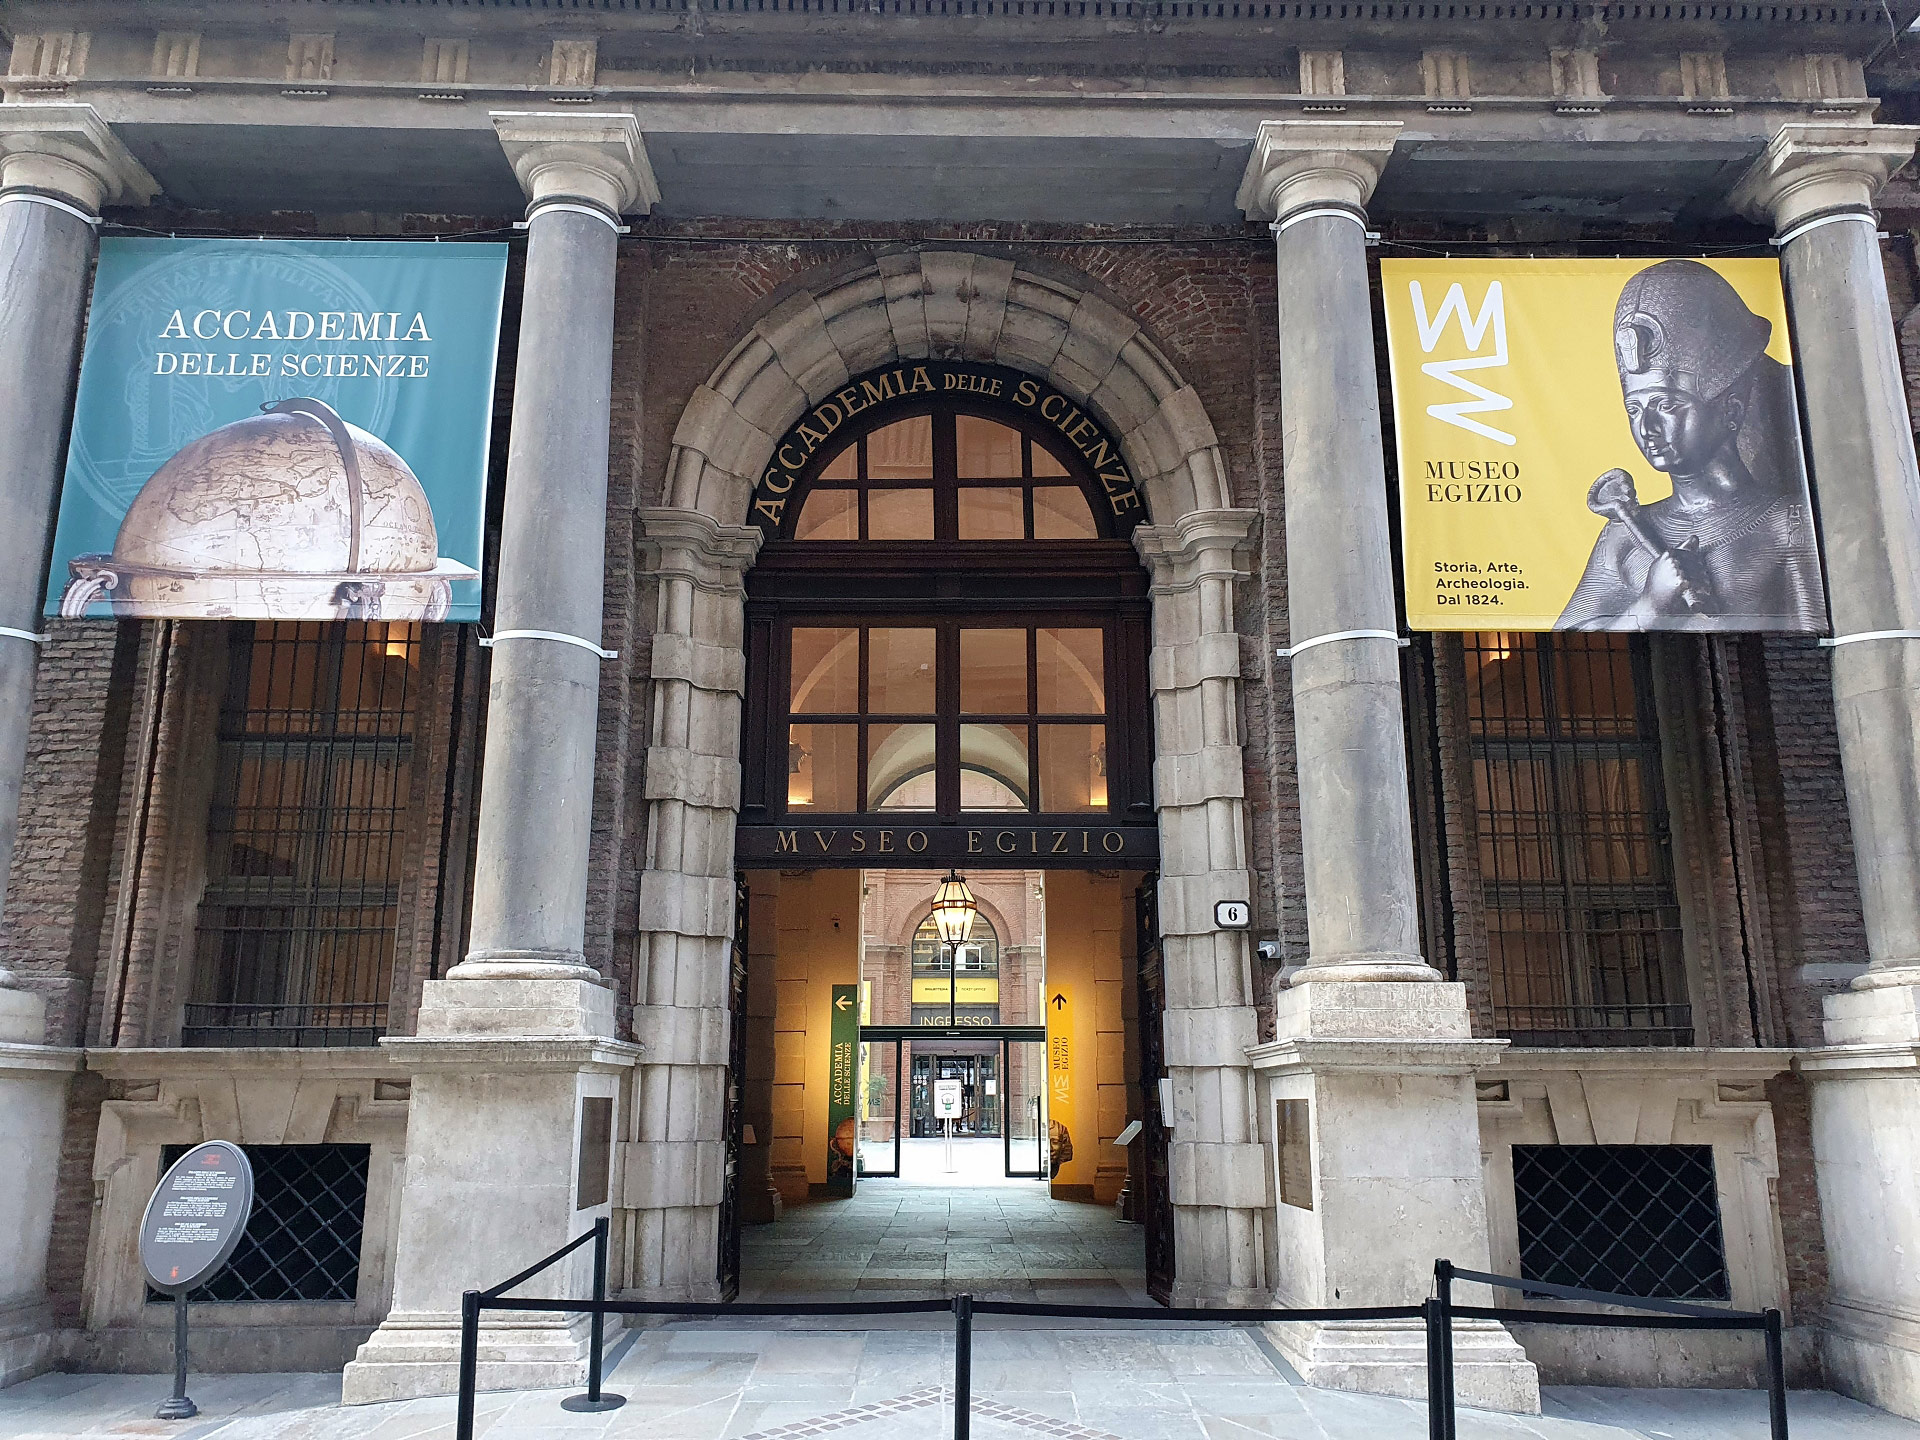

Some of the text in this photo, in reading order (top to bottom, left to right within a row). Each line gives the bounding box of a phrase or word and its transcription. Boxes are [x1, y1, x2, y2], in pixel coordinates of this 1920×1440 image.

[158, 308, 433, 342] ACCADEMIA
[153, 352, 430, 378] DELLE SCIENZE
[754, 366, 1141, 526] ACCADEMIA DELLE SCIENZE
[1424, 460, 1520, 480] MUSEO
[1425, 483, 1522, 503] EGIZIO
[1434, 561, 1523, 575] Storia, Arte,
[1435, 577, 1530, 591] Archeologia.
[1436, 594, 1504, 606] Dal 1824.
[774, 830, 1125, 853] MVSEO EGIZIO
[1228, 906, 1238, 922] 6
[844, 1042, 852, 1076] SCIENZE
[1053, 1037, 1061, 1070] MUSEO
[1061, 1037, 1069, 1070] EGIZIO
[834, 1042, 843, 1105] ACCADEMIA
